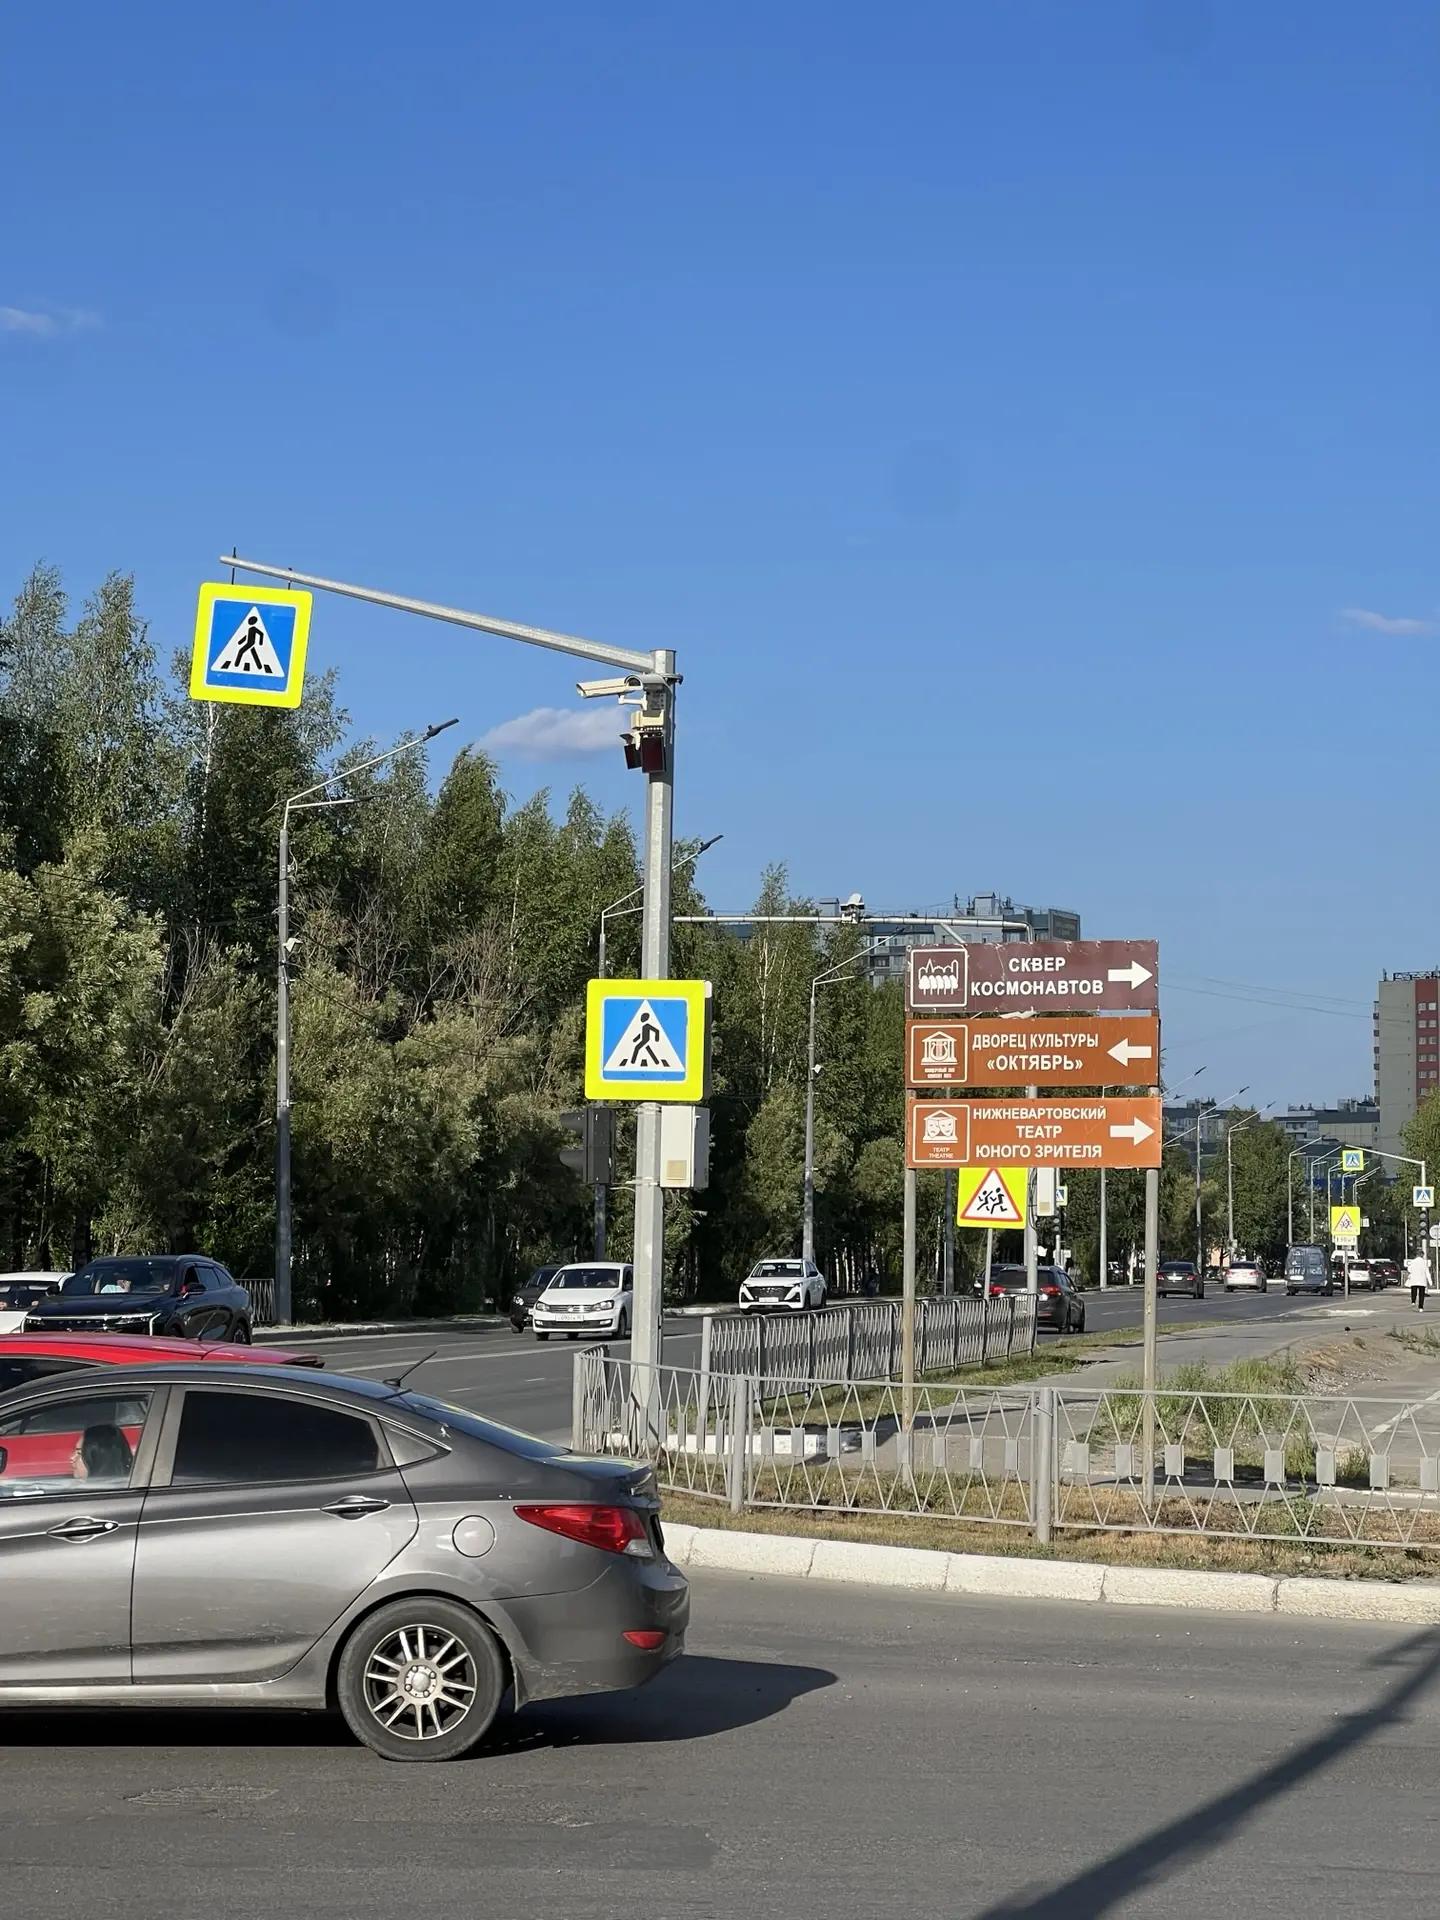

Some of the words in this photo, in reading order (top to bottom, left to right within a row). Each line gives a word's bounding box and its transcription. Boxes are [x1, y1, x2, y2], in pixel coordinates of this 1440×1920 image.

[1008, 957, 1066, 972] СКВЕР
[971, 980, 1104, 996] КОСМОНАВТОВ
[972, 1034, 1027, 1050] ДВОРЕЦ
[1030, 1033, 1099, 1048] КУЛЬТУРЫ
[987, 1055, 1084, 1070] «ОКТЯБРЬ»
[973, 1105, 1106, 1120] НИЖНЕВАРТОВСКИЙ
[1016, 1126, 1063, 1139] ТЕАТР
[975, 1145, 1031, 1159] ЮНОГО
[1034, 1144, 1102, 1158] ЗРИТЕЛЯ
